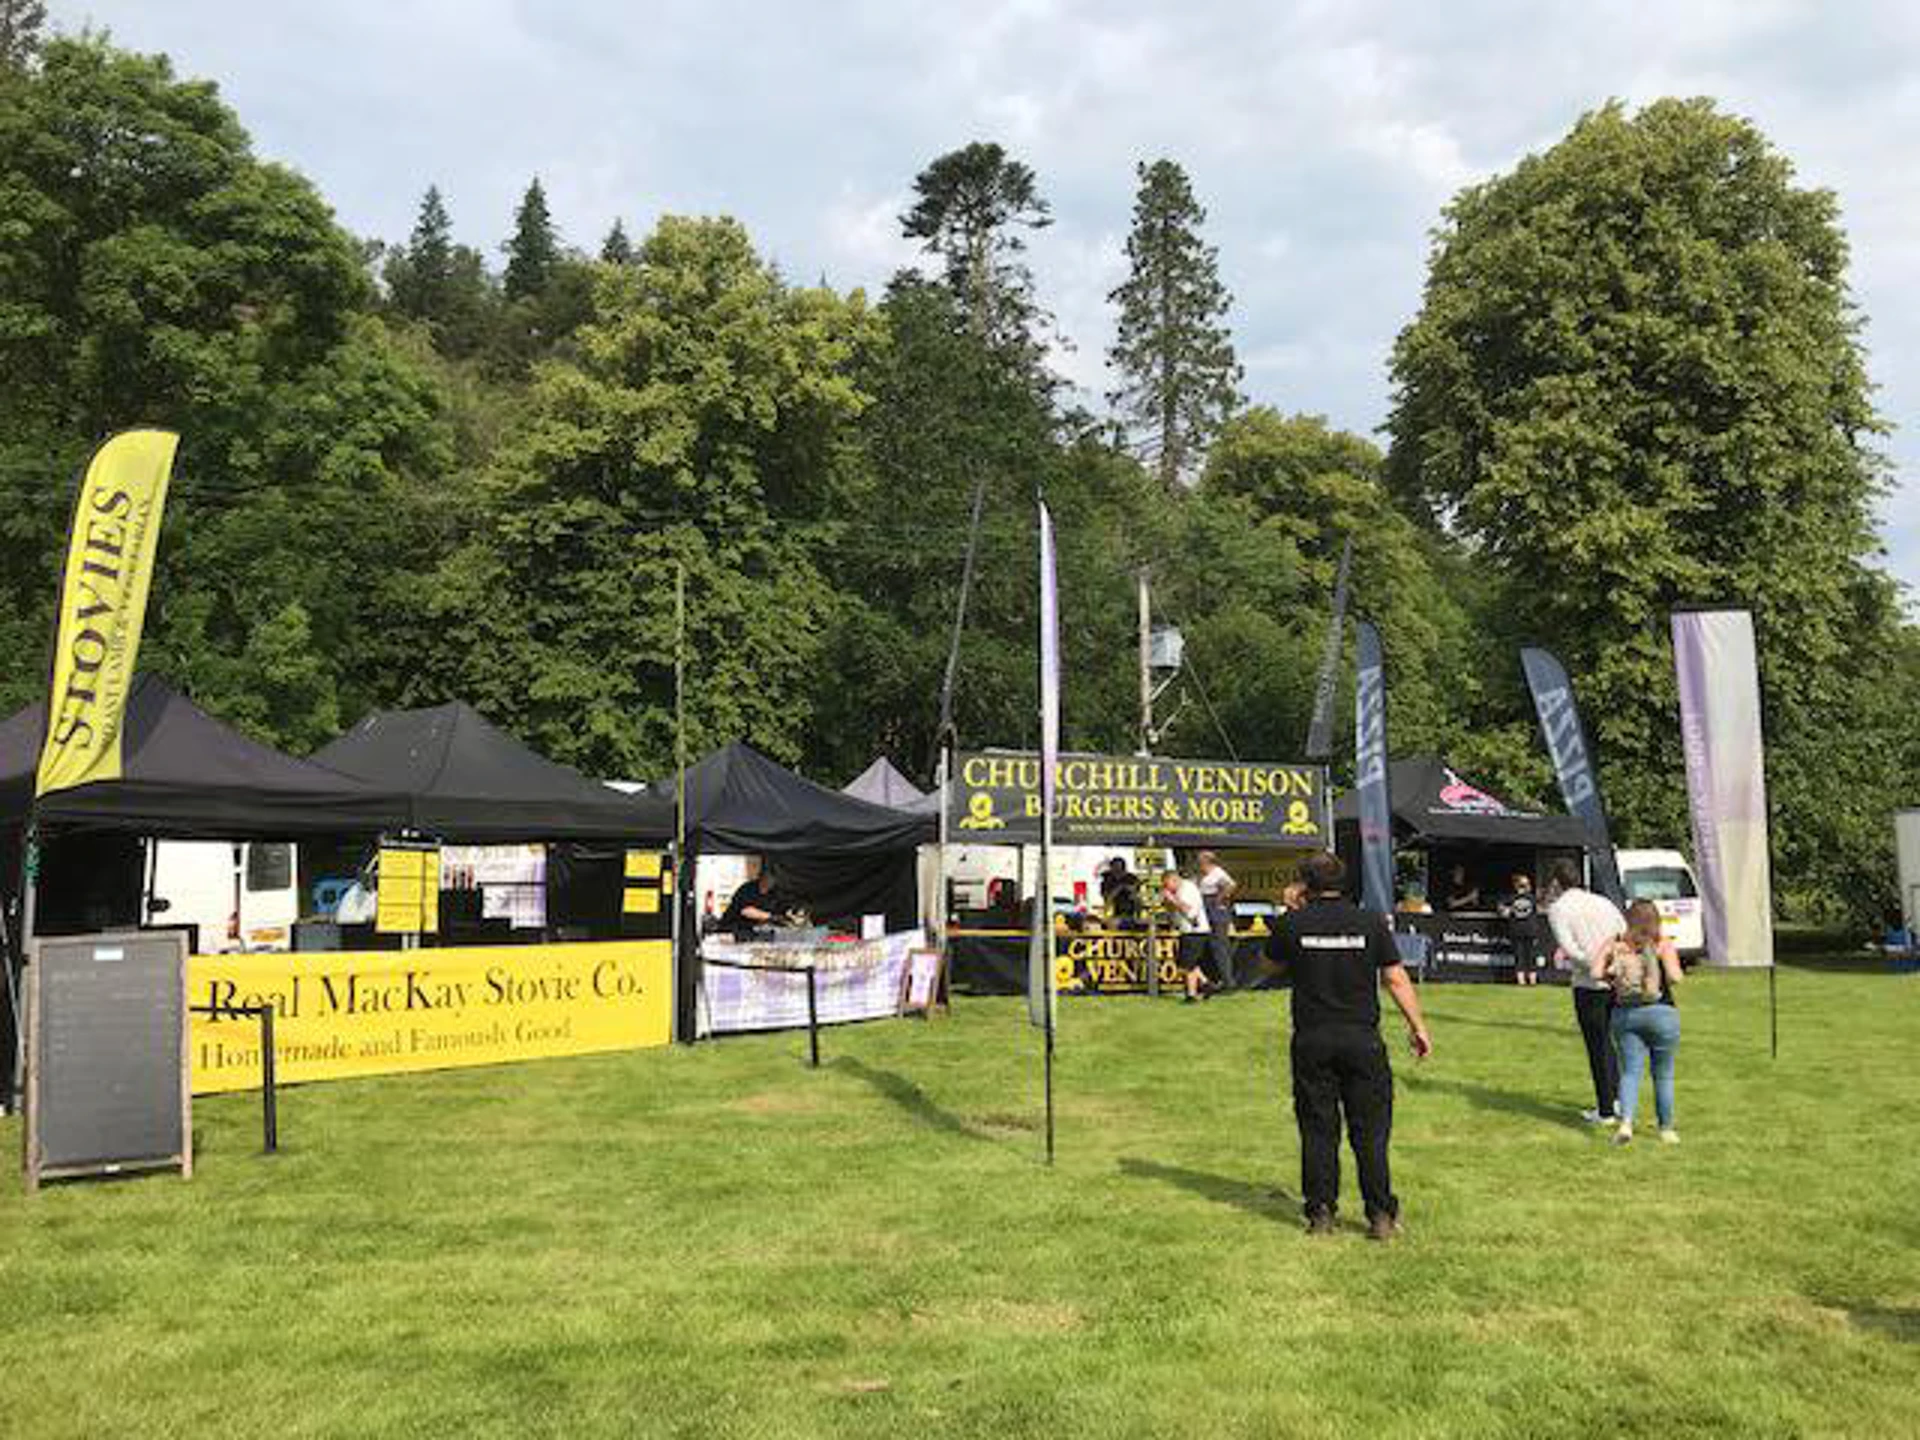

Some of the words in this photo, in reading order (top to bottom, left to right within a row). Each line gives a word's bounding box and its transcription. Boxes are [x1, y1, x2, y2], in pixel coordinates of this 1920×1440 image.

[54, 487, 131, 749] STOVIES
[963, 758, 1168, 793] CHURCHILL
[1175, 767, 1314, 797] VENISON
[1025, 794, 1153, 820] BURGERS
[1160, 798, 1181, 820] &
[1188, 798, 1265, 824] MORE
[1068, 937, 1180, 959] CHURCH
[1087, 959, 1183, 983] VENISO
[207, 976, 299, 1023] Real
[318, 971, 472, 1018] MacKay
[483, 964, 580, 1006] Stovie
[592, 959, 644, 1001] Co.
[200, 1034, 352, 1070] Hommade
[358, 1029, 401, 1057] and
[410, 1021, 508, 1052] Famously
[515, 1016, 571, 1044] Good
